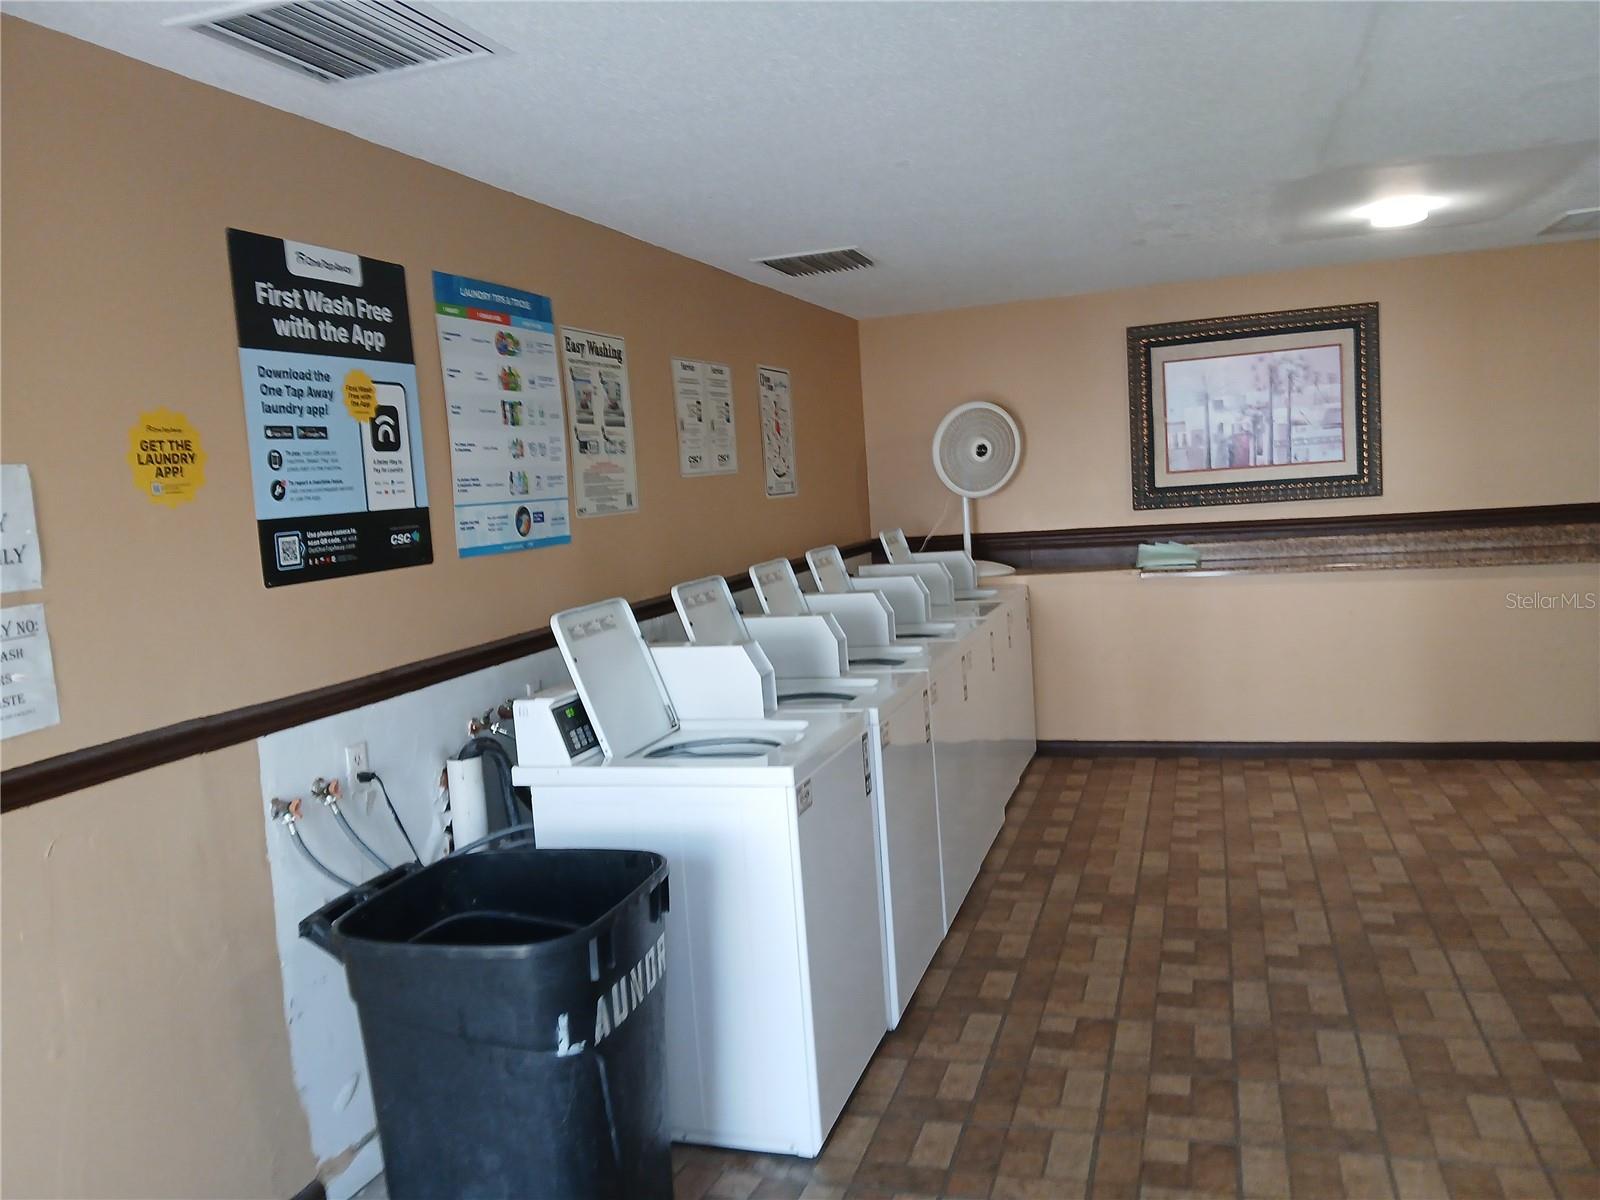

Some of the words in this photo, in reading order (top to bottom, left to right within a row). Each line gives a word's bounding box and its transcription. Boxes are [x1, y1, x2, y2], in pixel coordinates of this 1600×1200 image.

[255, 280, 303, 310] First
[302, 288, 356, 318] Wash
[355, 297, 393, 323] Free
[272, 314, 318, 340] with
[318, 320, 350, 344] the
[351, 323, 385, 352] App
[563, 335, 586, 358] Easy
[586, 339, 623, 361] Washing
[257, 365, 311, 381] Download
[313, 370, 331, 382] the
[260, 383, 283, 397] One
[284, 384, 304, 400] Tap
[306, 386, 334, 402] Away
[261, 401, 303, 417] laundry
[306, 404, 329, 418] app!
[140, 440, 165, 452] GET
[167, 440, 193, 451] THE
[136, 452, 196, 465] LAUNDRY
[155, 465, 184, 478] APP!
[0, 544, 26, 565] LY
